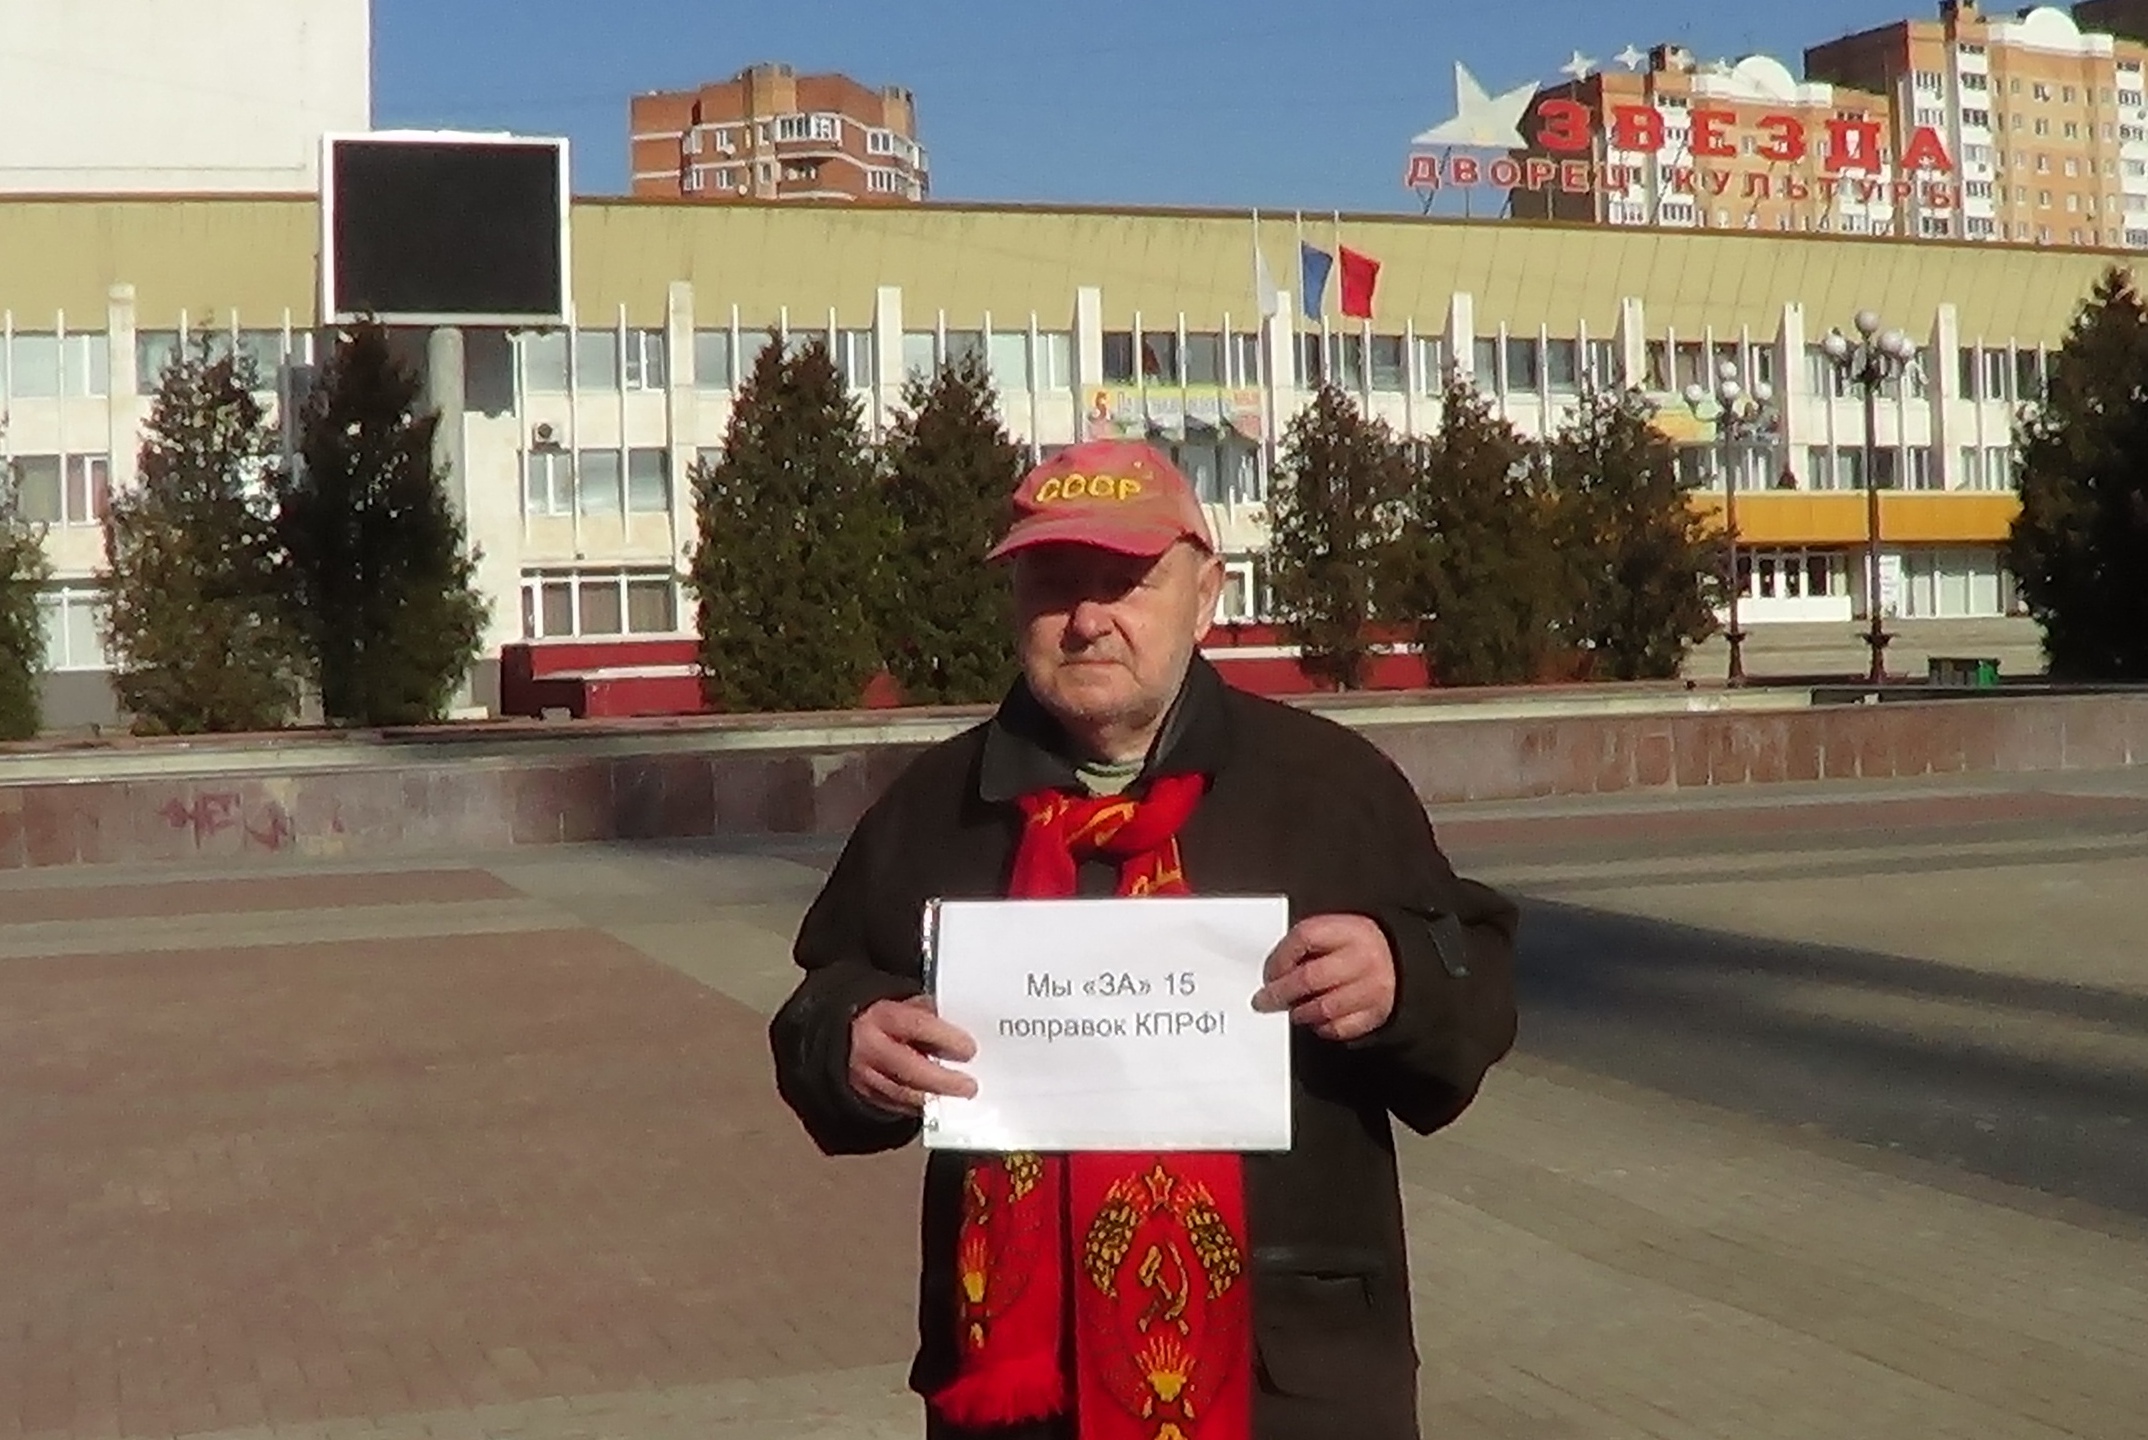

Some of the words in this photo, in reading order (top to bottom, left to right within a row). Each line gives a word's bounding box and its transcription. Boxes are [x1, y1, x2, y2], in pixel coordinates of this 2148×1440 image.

[1536, 98, 1954, 177] ЗВЕЗДА
[1405, 153, 1631, 198] ДВОРЕЦ
[1673, 169, 1961, 210] КУЛЬТУРЫ
[1027, 973, 1072, 997] Мы
[1082, 972, 1151, 996] «ЗА»
[1164, 972, 1196, 996] 15
[999, 1017, 1127, 1043] поправок
[1136, 1011, 1225, 1037] КПРФ!
